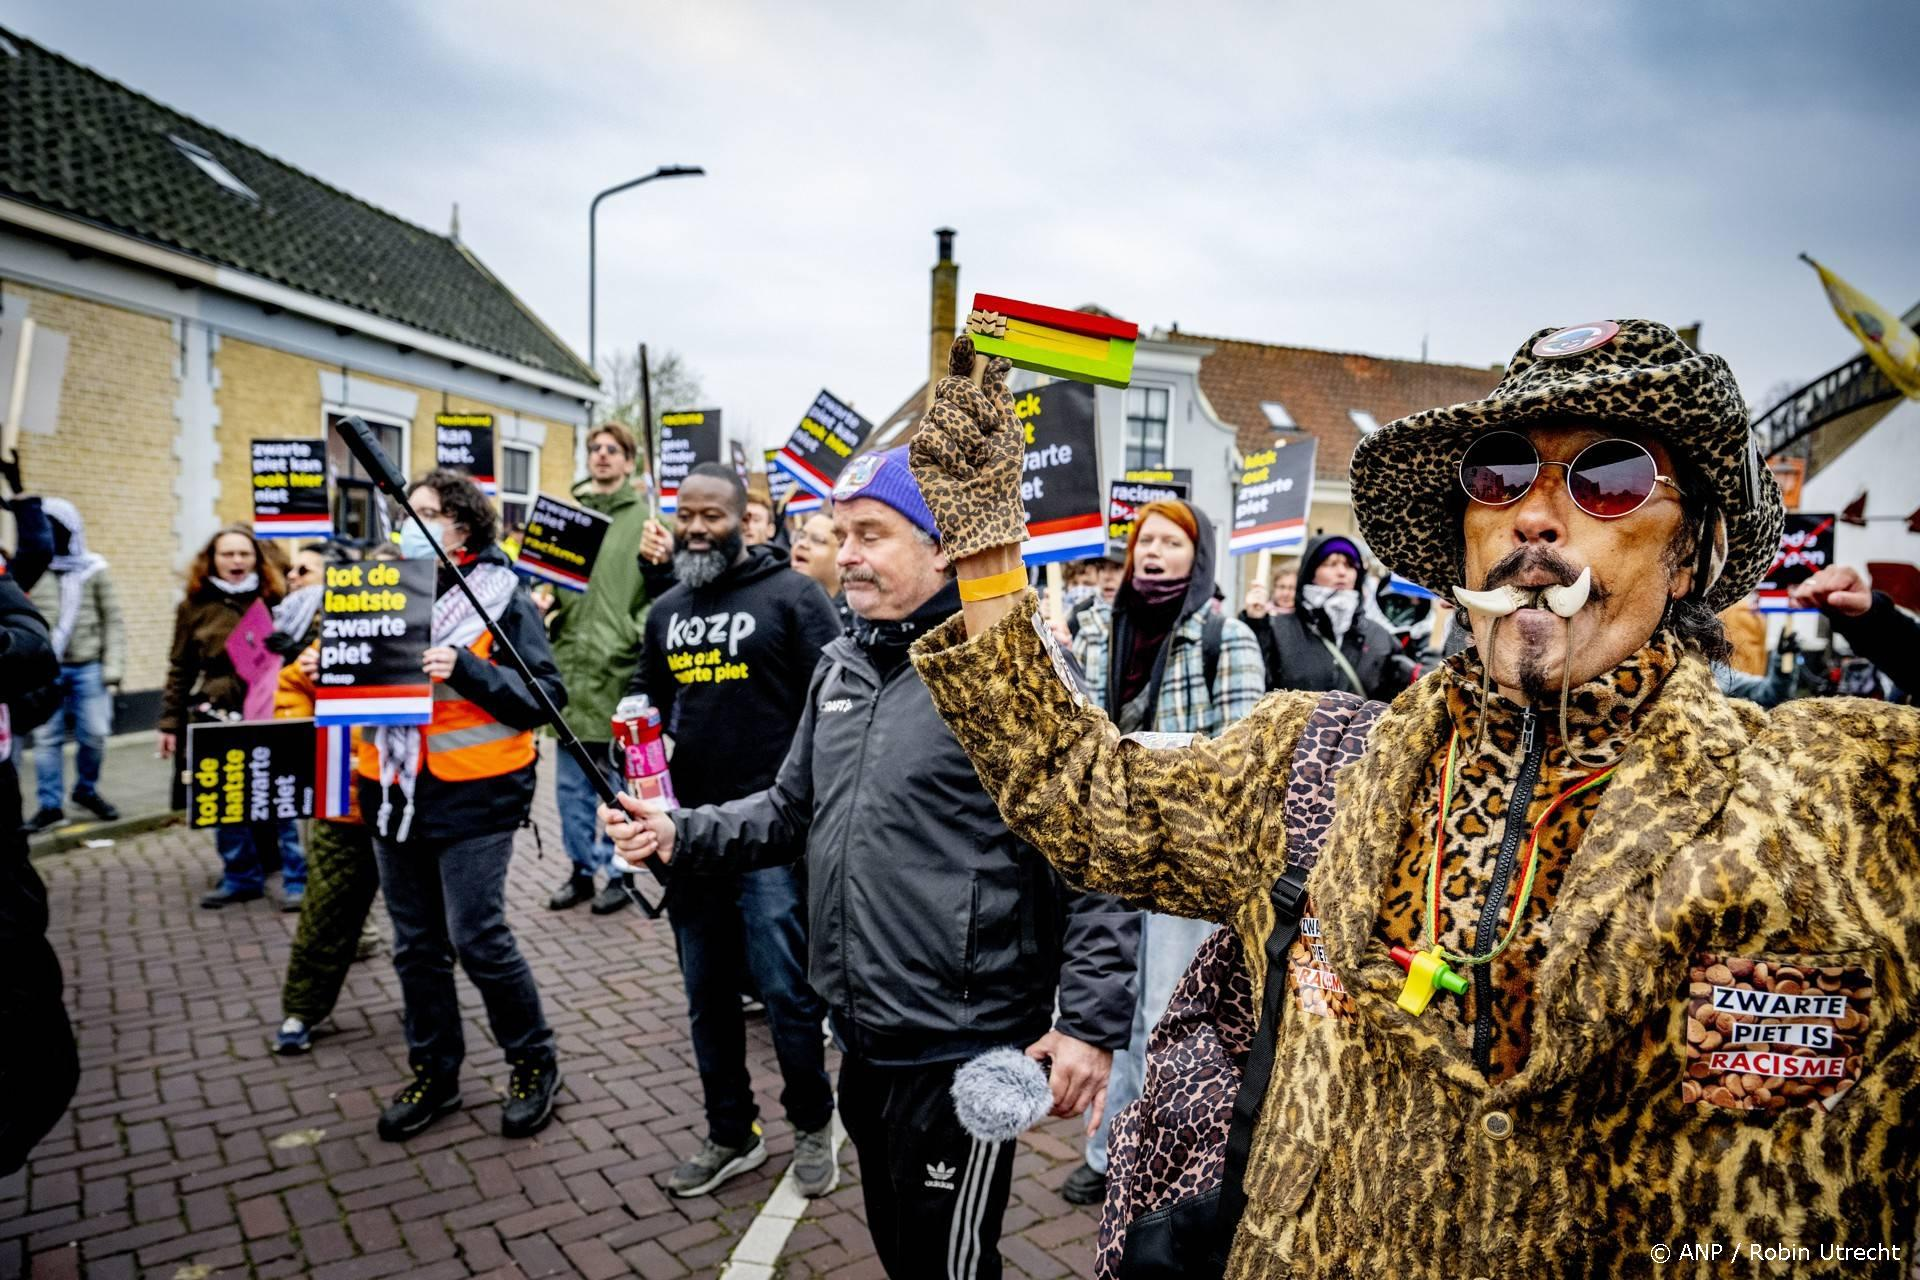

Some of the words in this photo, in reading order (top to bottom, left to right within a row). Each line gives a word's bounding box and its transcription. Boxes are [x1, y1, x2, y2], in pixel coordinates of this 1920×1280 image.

[1015, 392, 1042, 419] ck
[437, 426, 472, 445] kan
[1022, 443, 1072, 472] arte
[1021, 476, 1044, 500] et
[326, 565, 363, 587] tot
[367, 563, 400, 586] de
[324, 589, 407, 613] laatste
[322, 614, 407, 638] zwarte
[321, 641, 372, 669] piet
[715, 662, 749, 683] piet
[195, 758, 219, 788] de
[220, 749, 245, 823] laatste
[249, 746, 271, 821] zwarte
[195, 791, 218, 826] tot
[272, 774, 298, 818] piet
[1716, 988, 1844, 1015] ZWARTE
[1734, 1025, 1791, 1042] PIET
[1802, 1026, 1828, 1047] IS
[1711, 1053, 1844, 1076] RACISME
